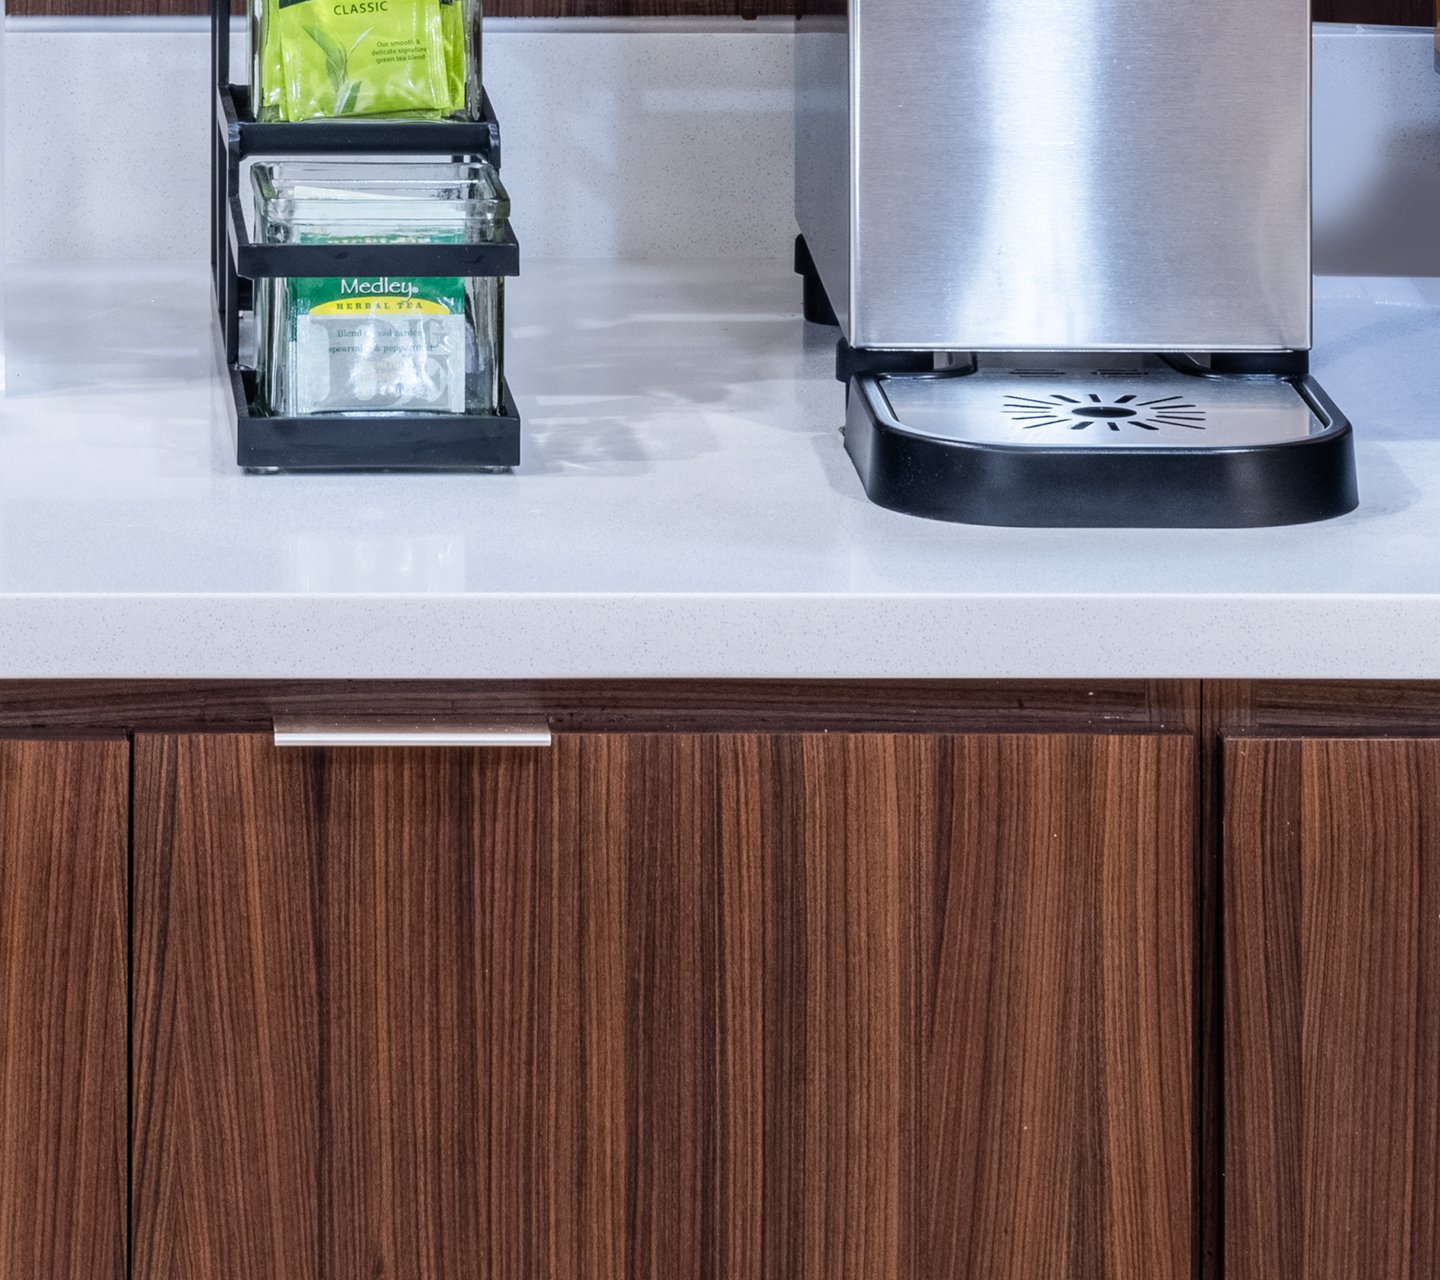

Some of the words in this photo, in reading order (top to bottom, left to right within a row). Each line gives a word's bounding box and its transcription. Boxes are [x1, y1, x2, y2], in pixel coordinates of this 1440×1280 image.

[333, 1, 388, 15] CLASSIC
[376, 56, 395, 64] green
[341, 277, 412, 302] Medley
[336, 302, 390, 310] HERBAL
